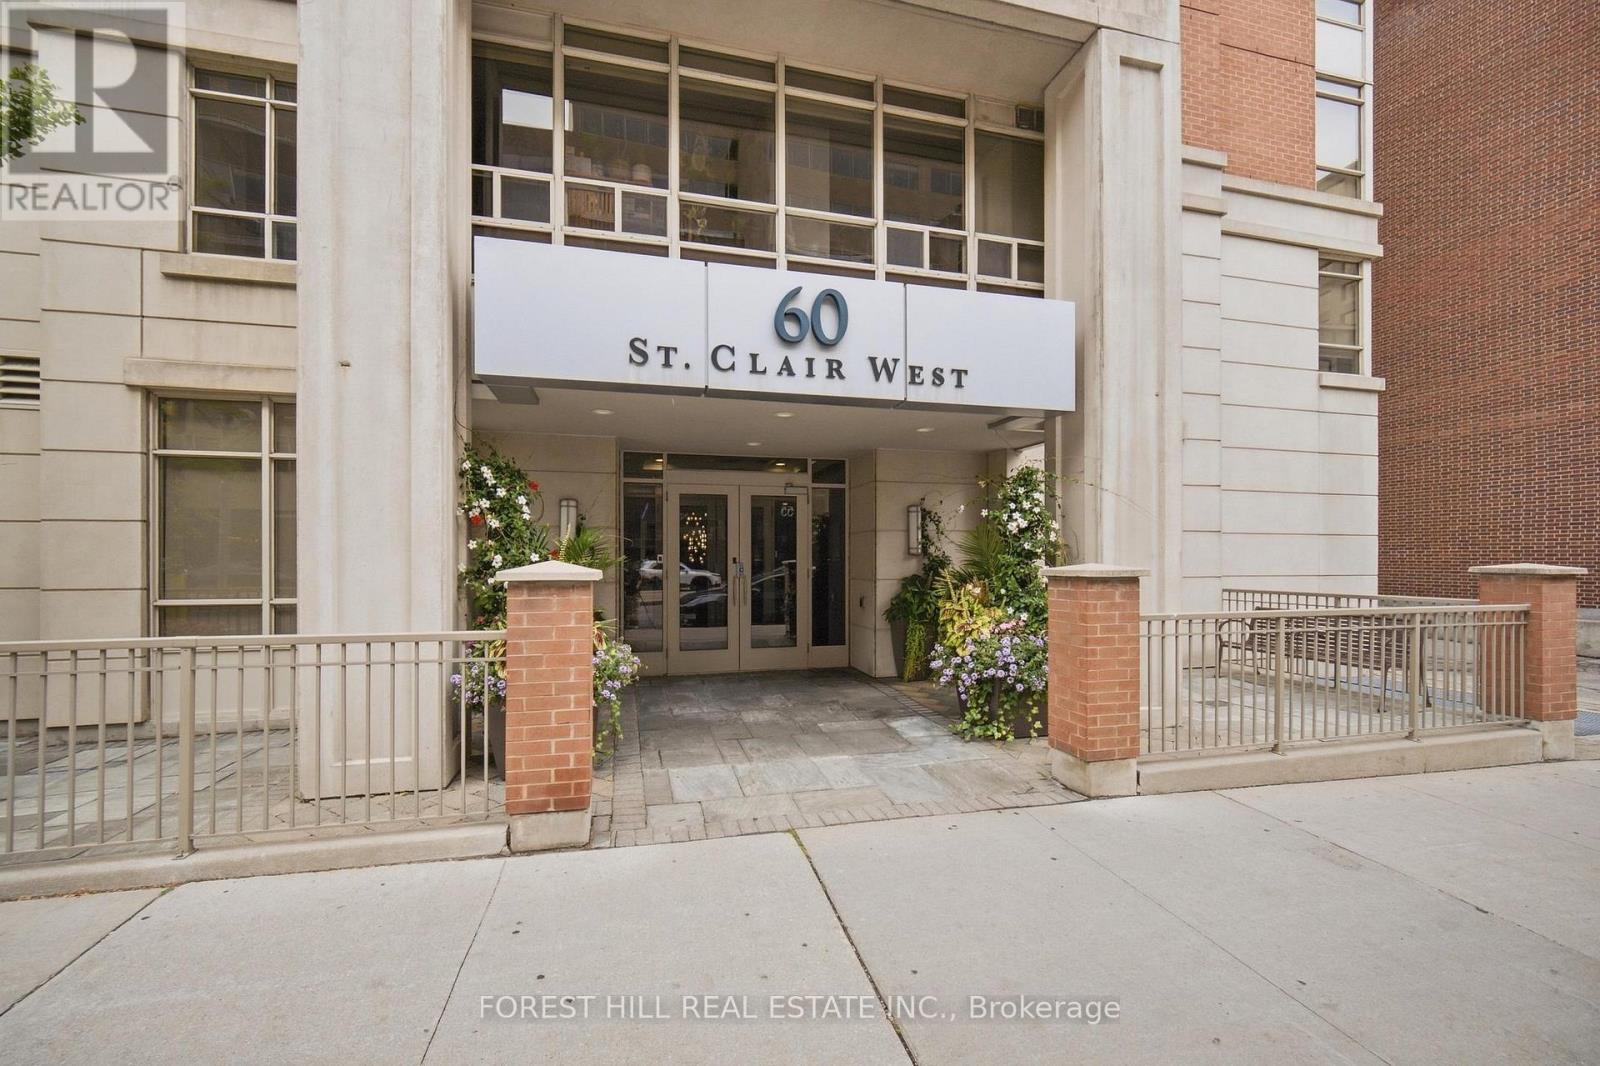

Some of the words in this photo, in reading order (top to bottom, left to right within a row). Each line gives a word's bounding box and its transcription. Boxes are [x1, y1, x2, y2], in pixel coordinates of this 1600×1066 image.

[773, 285, 849, 347] 60
[710, 344, 846, 381] CLAIR
[868, 355, 969, 389] WEST
